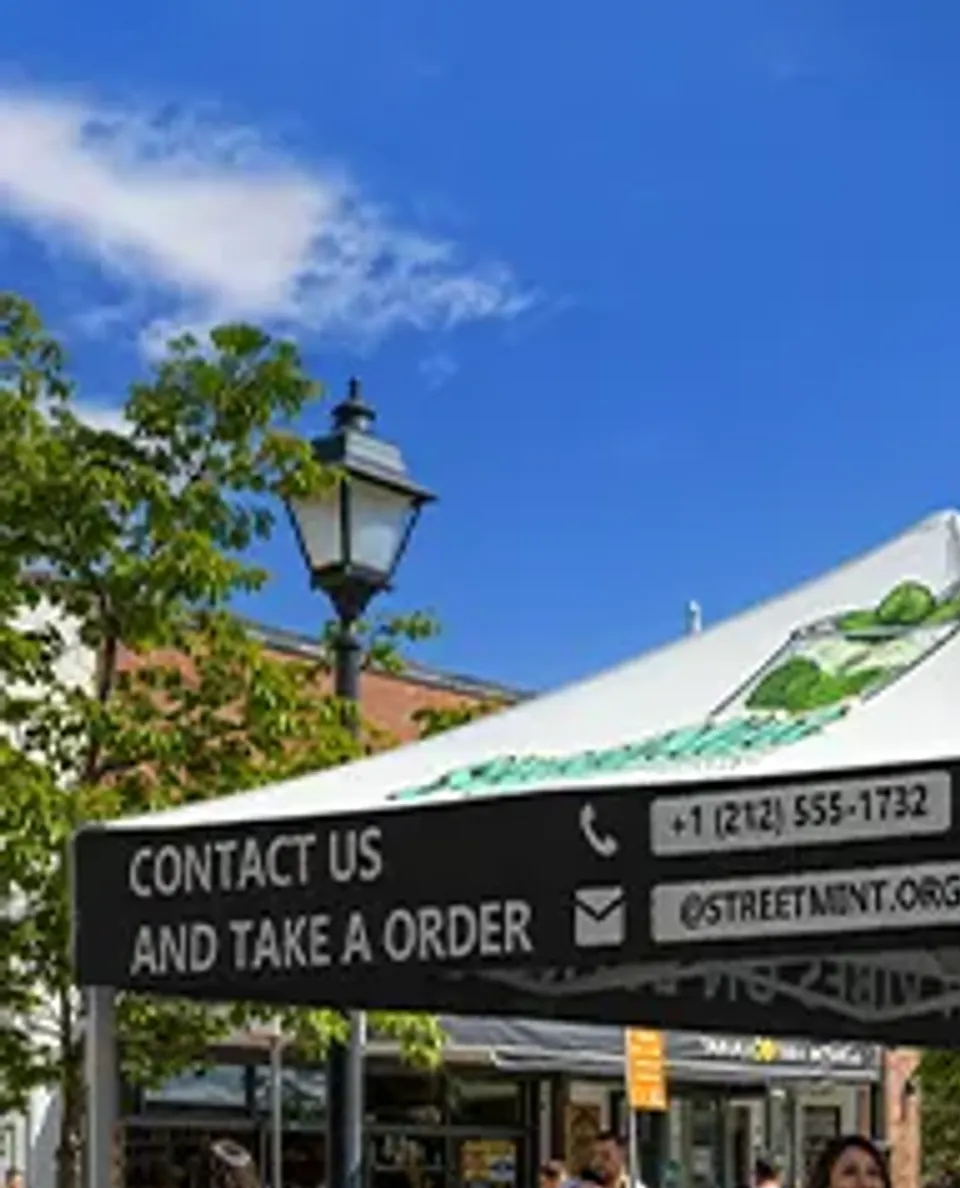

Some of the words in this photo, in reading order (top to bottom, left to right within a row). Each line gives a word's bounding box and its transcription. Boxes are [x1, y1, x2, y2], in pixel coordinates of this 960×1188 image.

[669, 807, 702, 837] +1
[714, 798, 783, 836] (212)
[793, 785, 928, 827] 555-1732
[129, 834, 316, 897] CONTACT
[328, 827, 383, 882] US
[130, 924, 217, 976] AND
[230, 912, 331, 971] TAKE
[340, 912, 371, 964] A
[383, 900, 533, 962] ORDER
